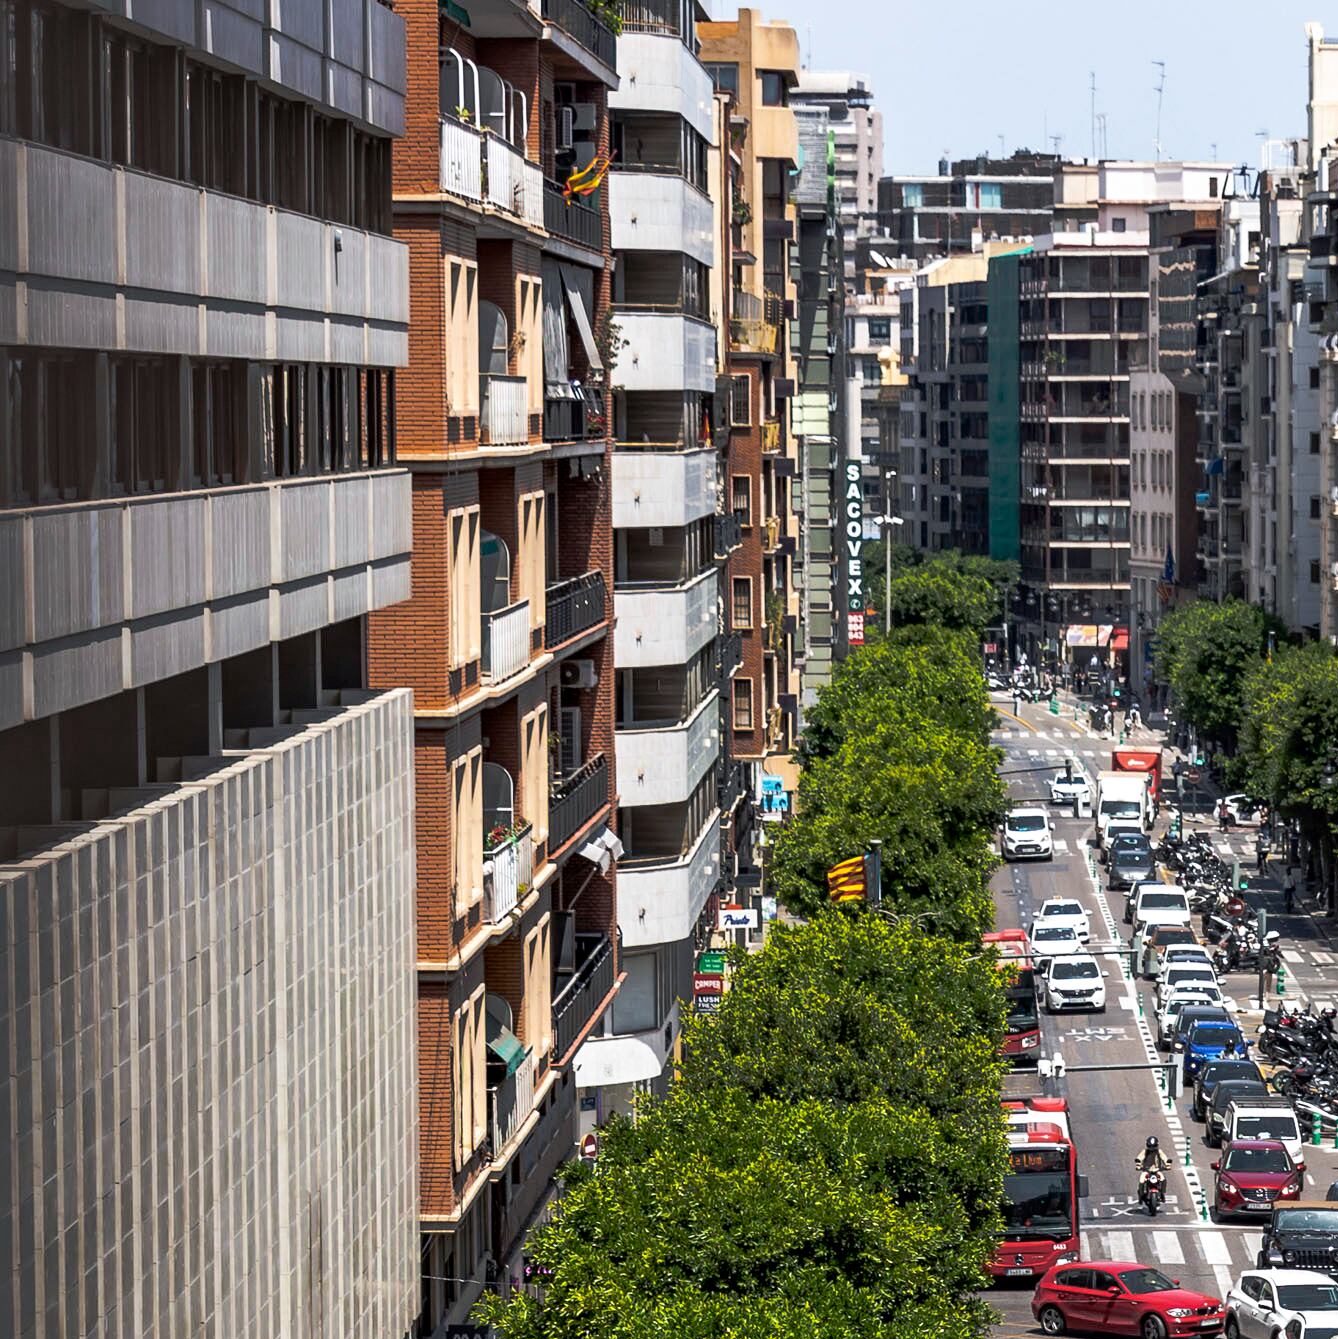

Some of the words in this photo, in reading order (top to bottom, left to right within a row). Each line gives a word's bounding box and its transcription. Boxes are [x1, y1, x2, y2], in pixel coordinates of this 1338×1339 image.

[846, 464, 862, 595] SACOVEX
[695, 980, 720, 989] CAMPER
[1092, 1206, 1190, 1217] TXI
